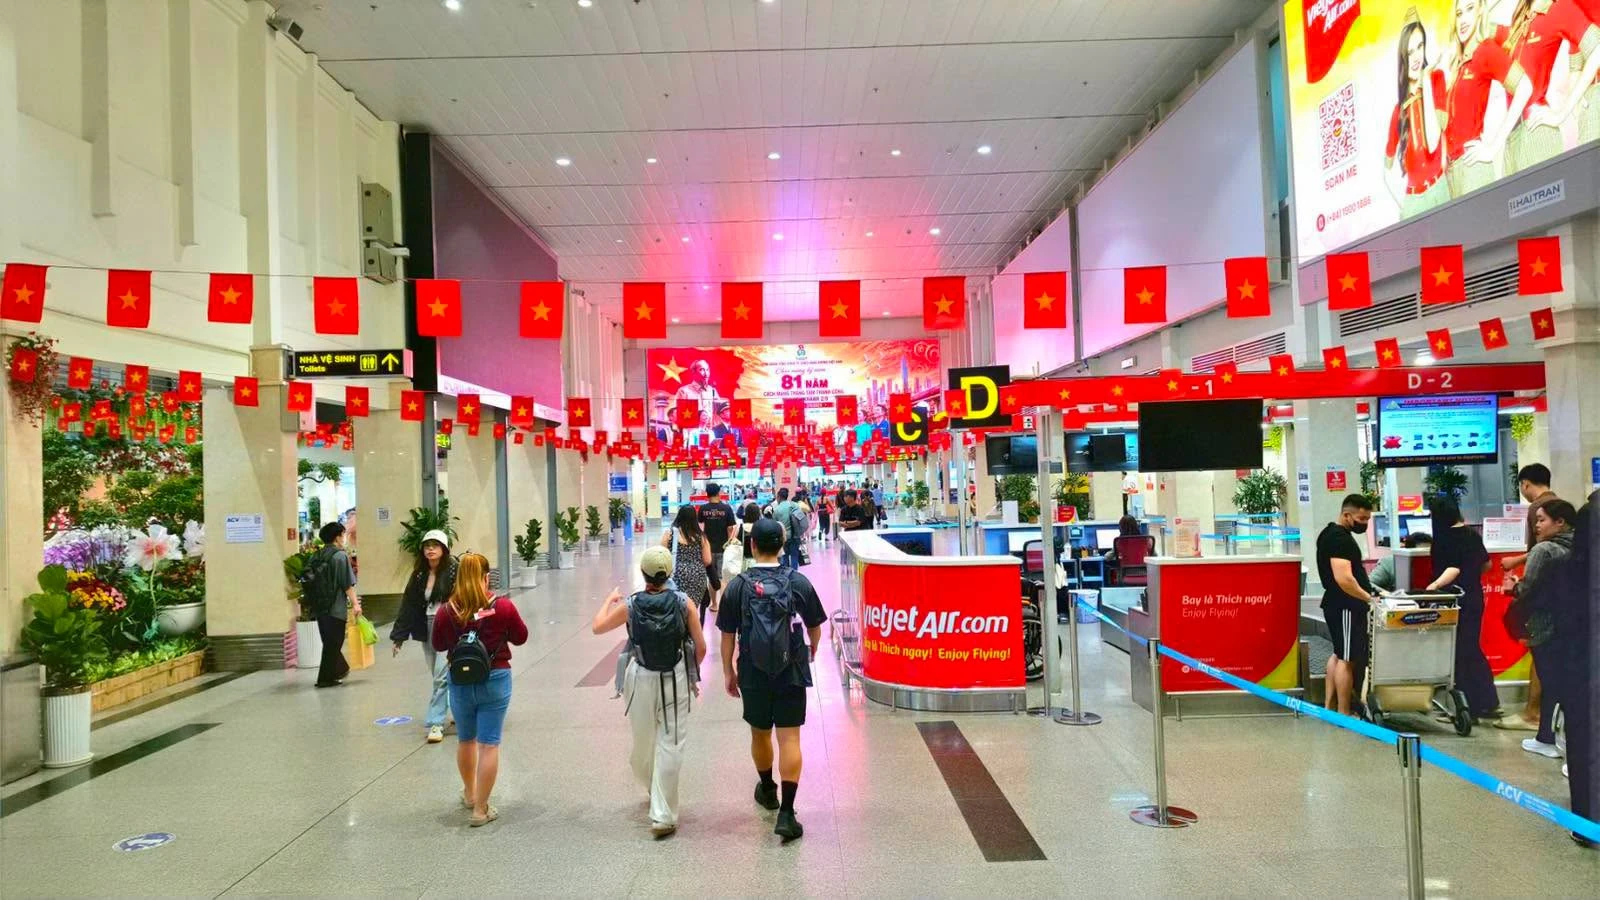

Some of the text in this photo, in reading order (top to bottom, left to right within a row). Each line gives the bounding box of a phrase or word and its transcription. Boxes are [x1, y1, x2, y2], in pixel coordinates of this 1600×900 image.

[1324, 164, 1358, 191] SCAN ME
[299, 353, 356, 364] NHÀ VỆ SINH
[299, 365, 326, 373] Toilets
[781, 374, 829, 390] 81 NĂM
[960, 375, 999, 421] D
[895, 412, 922, 442] C
[1182, 595, 1202, 606] Bay
[1203, 594, 1213, 604] là
[1244, 593, 1272, 605] ngay!
[1182, 607, 1239, 619] Enjoy Flying!
[902, 647, 933, 660] ngay!
[938, 647, 970, 661] Enjoy
[972, 647, 1011, 661] Flying!
[1497, 781, 1524, 804] ACV
